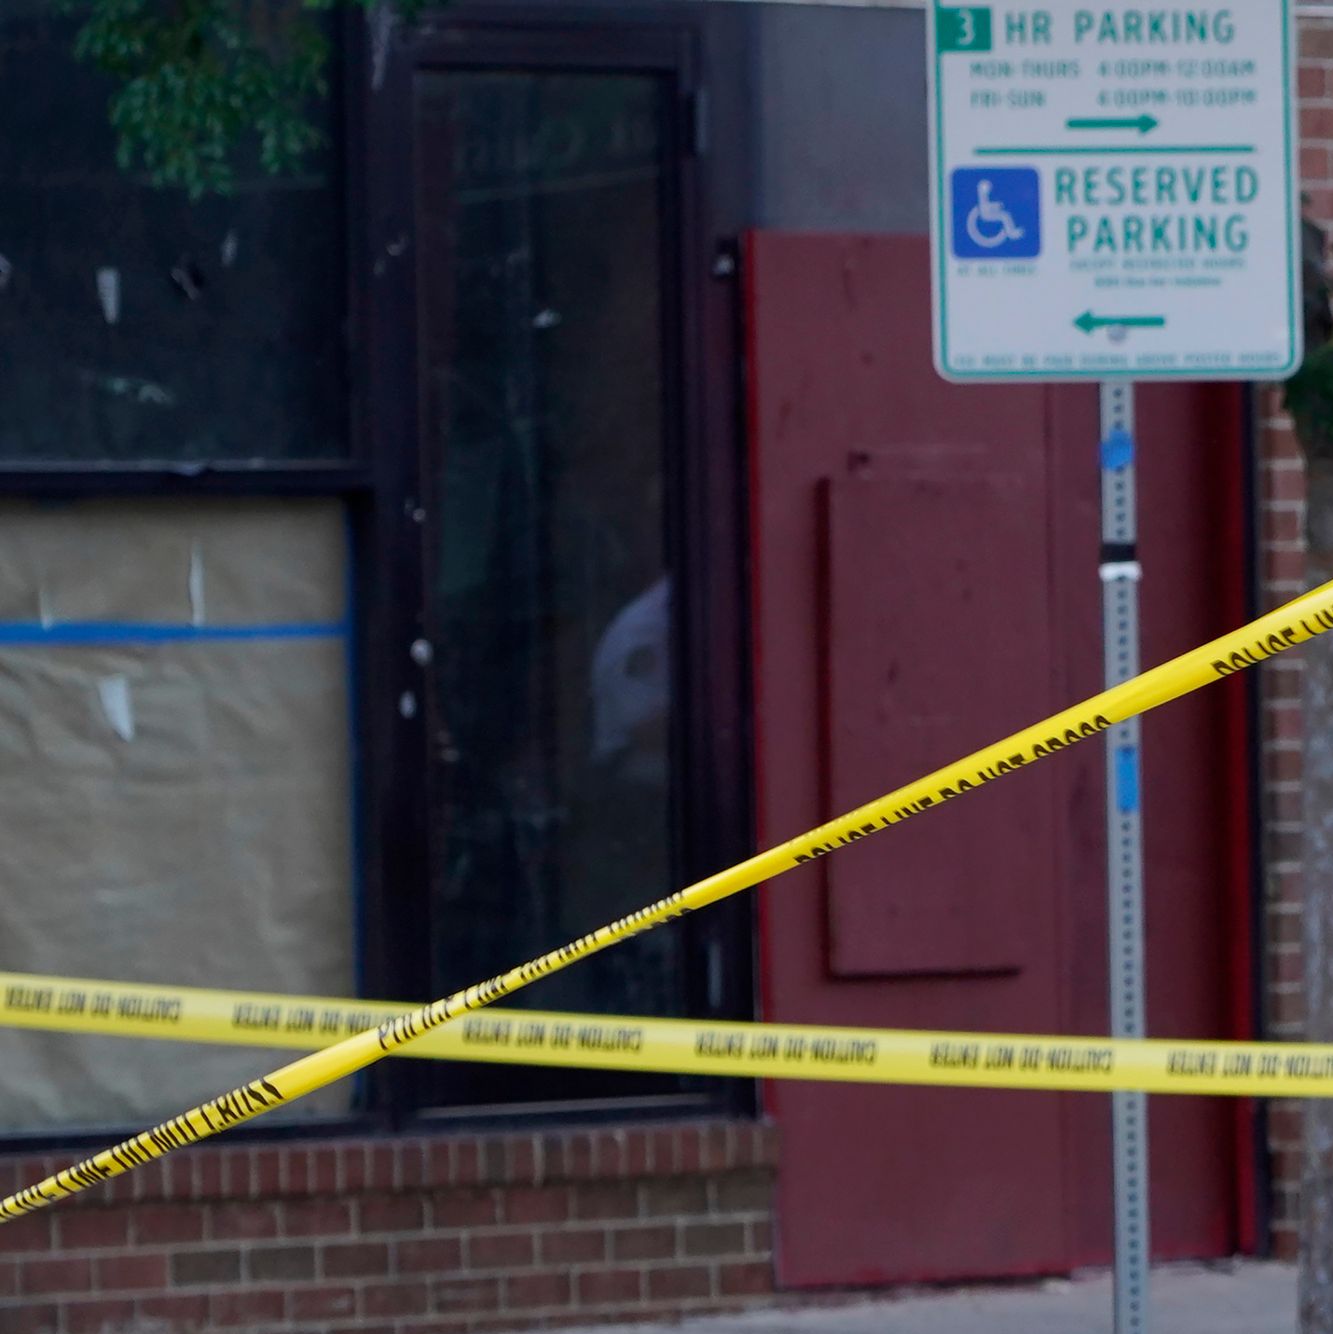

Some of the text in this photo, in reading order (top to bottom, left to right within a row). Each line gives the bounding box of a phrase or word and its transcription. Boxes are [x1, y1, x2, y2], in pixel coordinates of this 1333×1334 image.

[1004, 11, 1053, 45] HR
[1073, 10, 1236, 44] PARKING
[1055, 166, 1259, 206] RESERVED
[1067, 214, 1250, 255] PARKING
